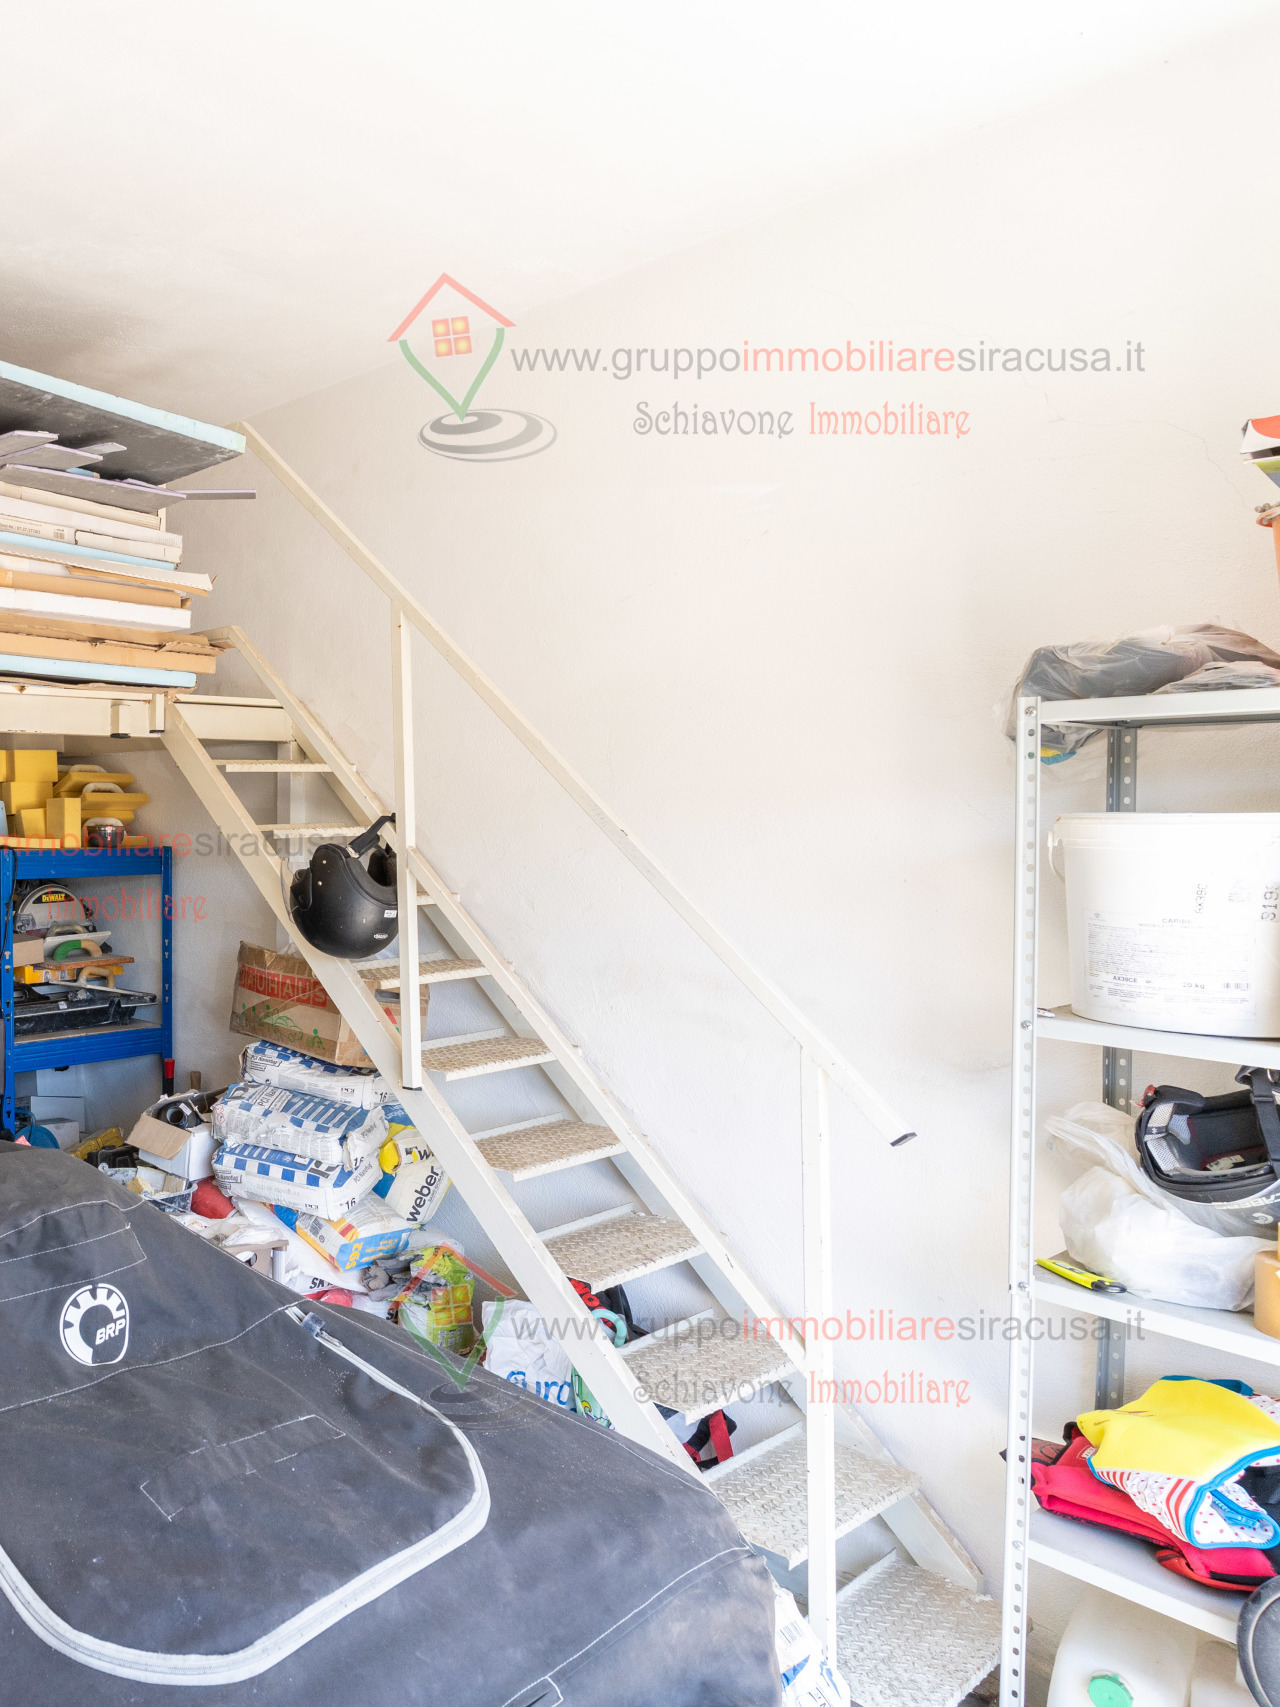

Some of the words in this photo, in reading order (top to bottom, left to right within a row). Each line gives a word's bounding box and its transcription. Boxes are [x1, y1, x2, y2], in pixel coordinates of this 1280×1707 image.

[345, 1197, 356, 1210] 16
[406, 1165, 441, 1222] weber
[345, 1242, 363, 1270] 592
[95, 1318, 126, 1345] BRP
